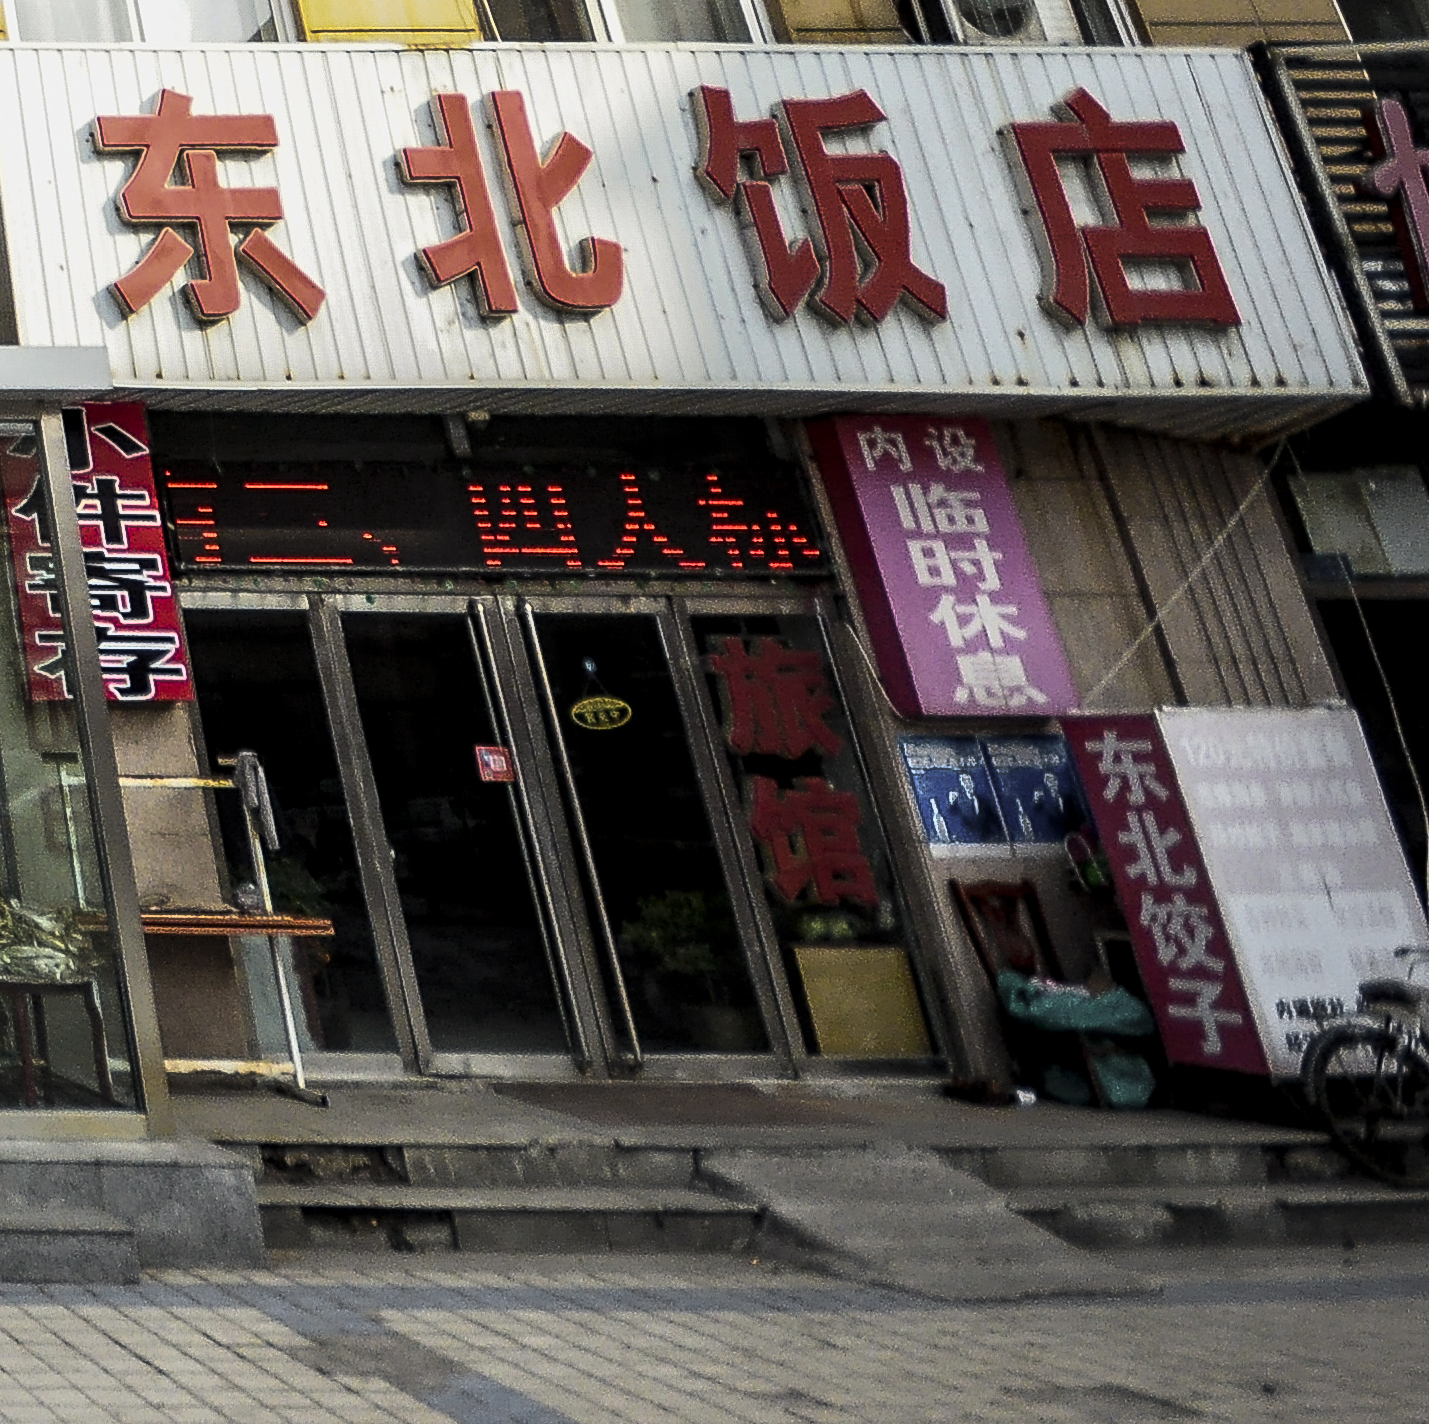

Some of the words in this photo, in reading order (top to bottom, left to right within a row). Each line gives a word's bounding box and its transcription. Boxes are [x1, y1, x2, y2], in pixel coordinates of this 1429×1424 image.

[92, 83, 1244, 330] 东北饭店
[857, 426, 986, 474] 内设
[889, 483, 1048, 708] 临时休息
[709, 636, 880, 906] 旅馆
[1085, 729, 1244, 1057] 东北饺子
